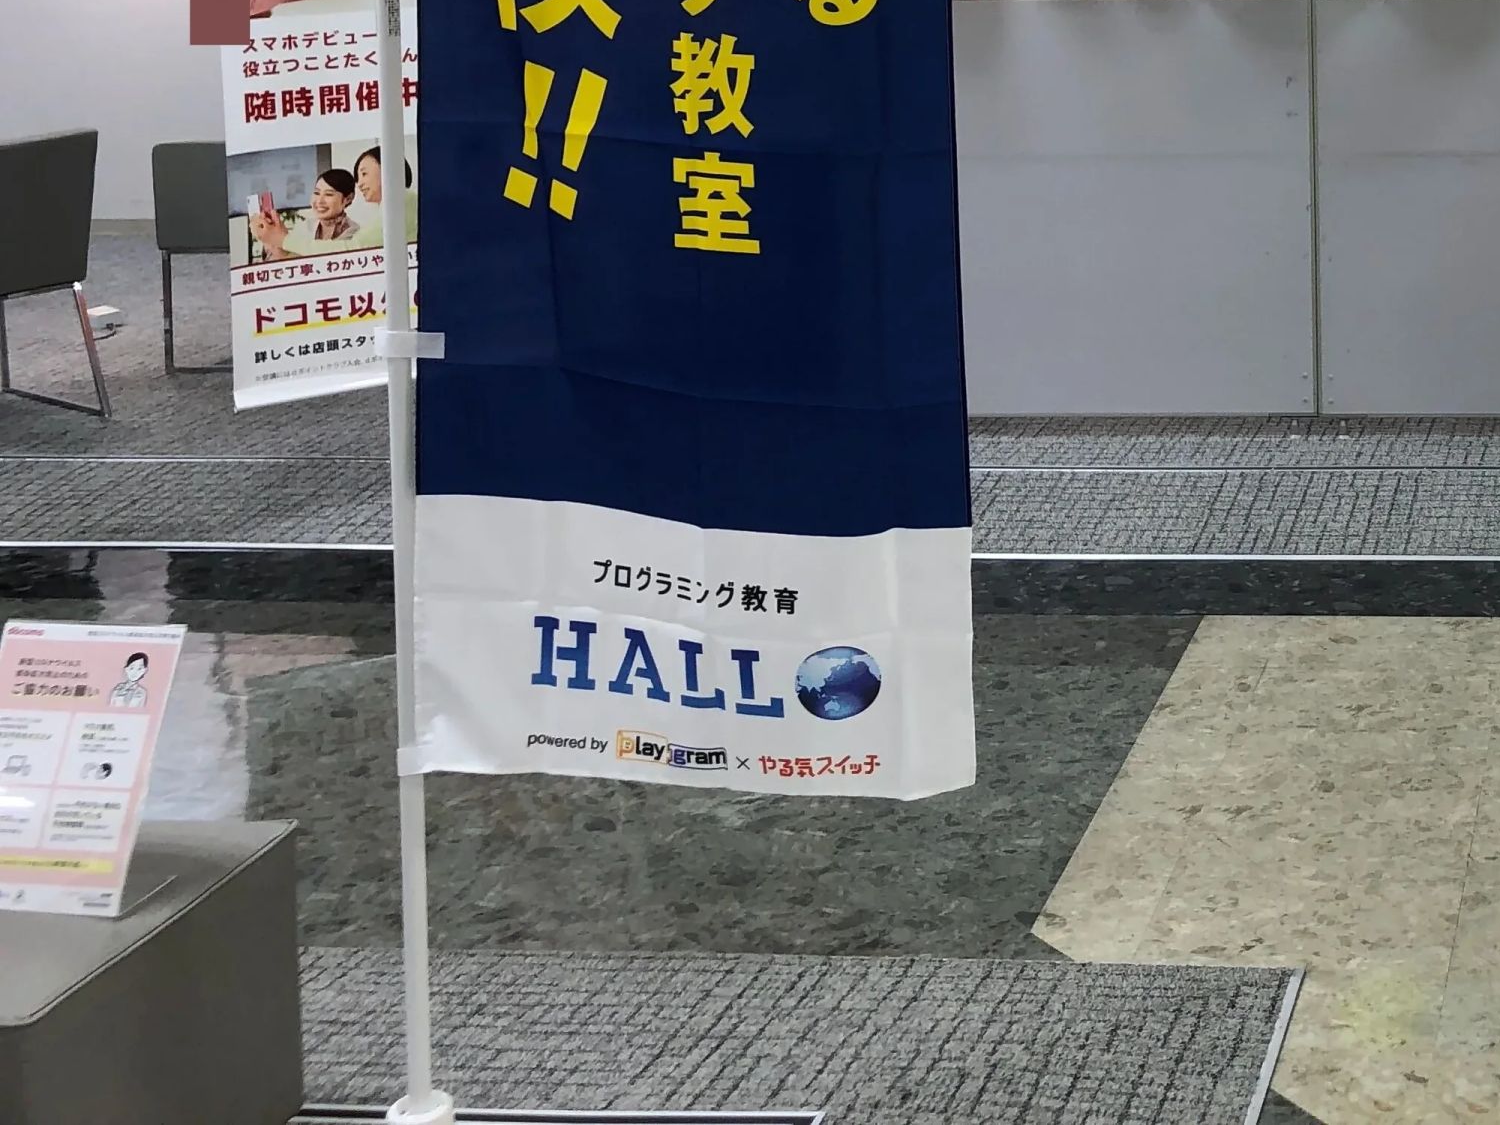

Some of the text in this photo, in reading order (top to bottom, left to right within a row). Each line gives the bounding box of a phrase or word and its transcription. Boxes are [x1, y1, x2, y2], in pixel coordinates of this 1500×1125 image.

[243, 48, 417, 78] 役立つことたくん
[593, 559, 800, 615] プログラミング教育
[527, 732, 586, 750] powered
[590, 736, 608, 753] by
[758, 754, 881, 777] やる気スイッチ
